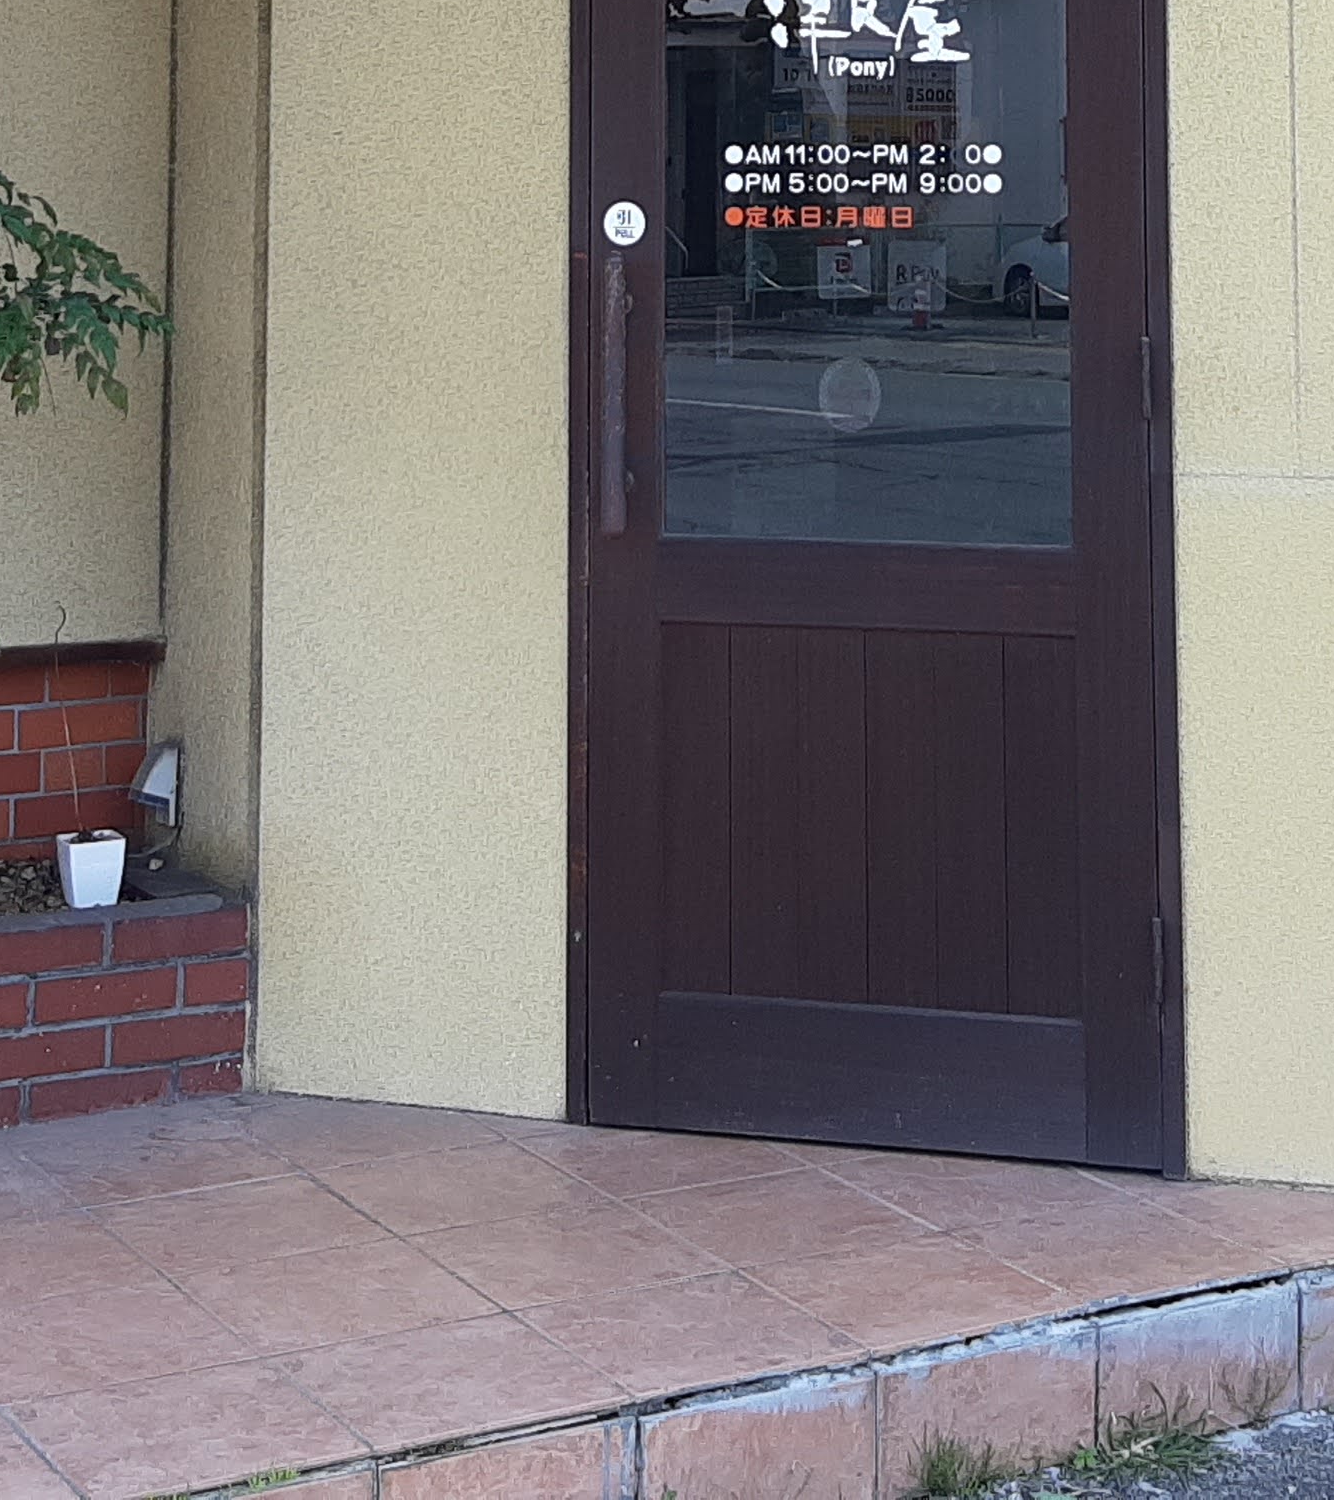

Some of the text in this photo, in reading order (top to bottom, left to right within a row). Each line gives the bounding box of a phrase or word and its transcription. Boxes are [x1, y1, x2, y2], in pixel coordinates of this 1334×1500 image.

[828, 55, 895, 80] (Pony)
[746, 145, 780, 164] AM
[745, 173, 780, 193] PM
[919, 173, 979, 193] 9:00
